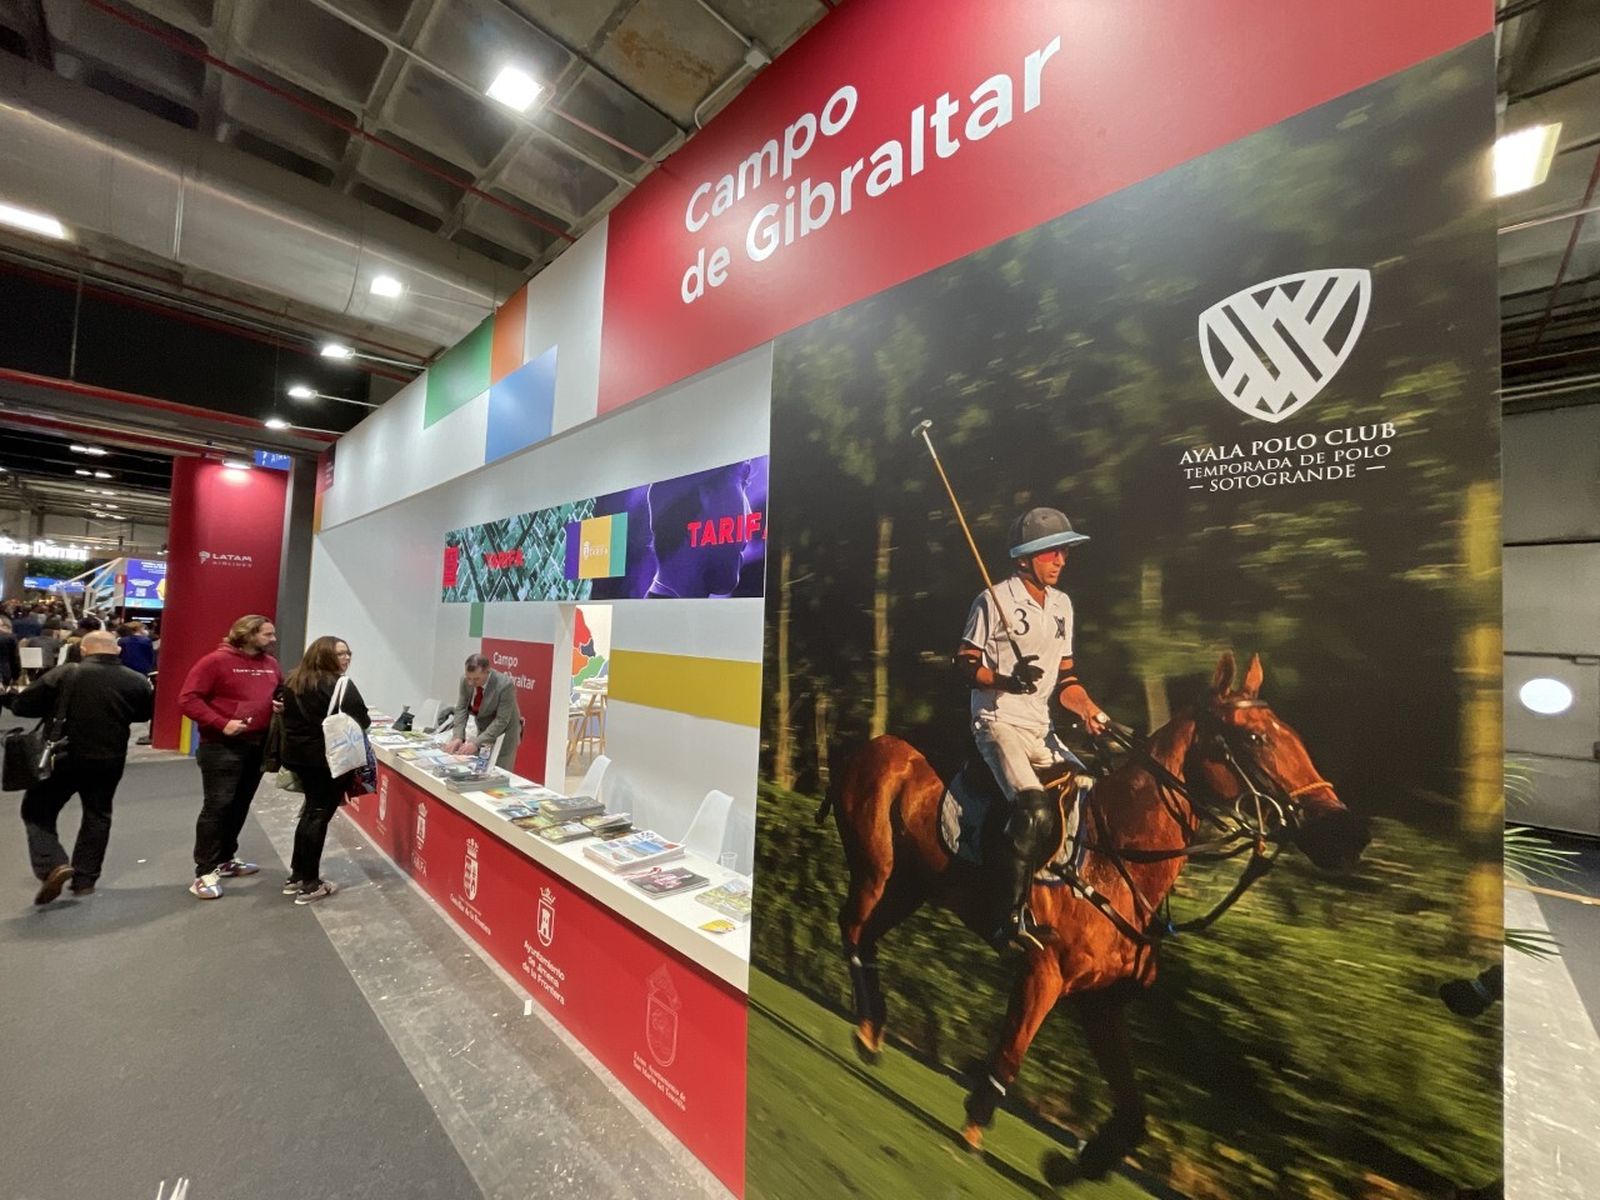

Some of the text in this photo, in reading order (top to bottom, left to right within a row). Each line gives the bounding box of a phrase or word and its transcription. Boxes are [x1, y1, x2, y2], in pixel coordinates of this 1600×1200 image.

[681, 35, 1061, 304] de Gibraltar
[685, 85, 858, 233] Campo
[1180, 422, 1397, 465] AYALA POLO CLUB
[1184, 444, 1392, 480] TEMPORADA DE POLO
[1209, 463, 1357, 492] SOTOGRANDE
[212, 553, 252, 562] LATAM
[1014, 608, 1030, 636] 3
[493, 652, 519, 669] Campo
